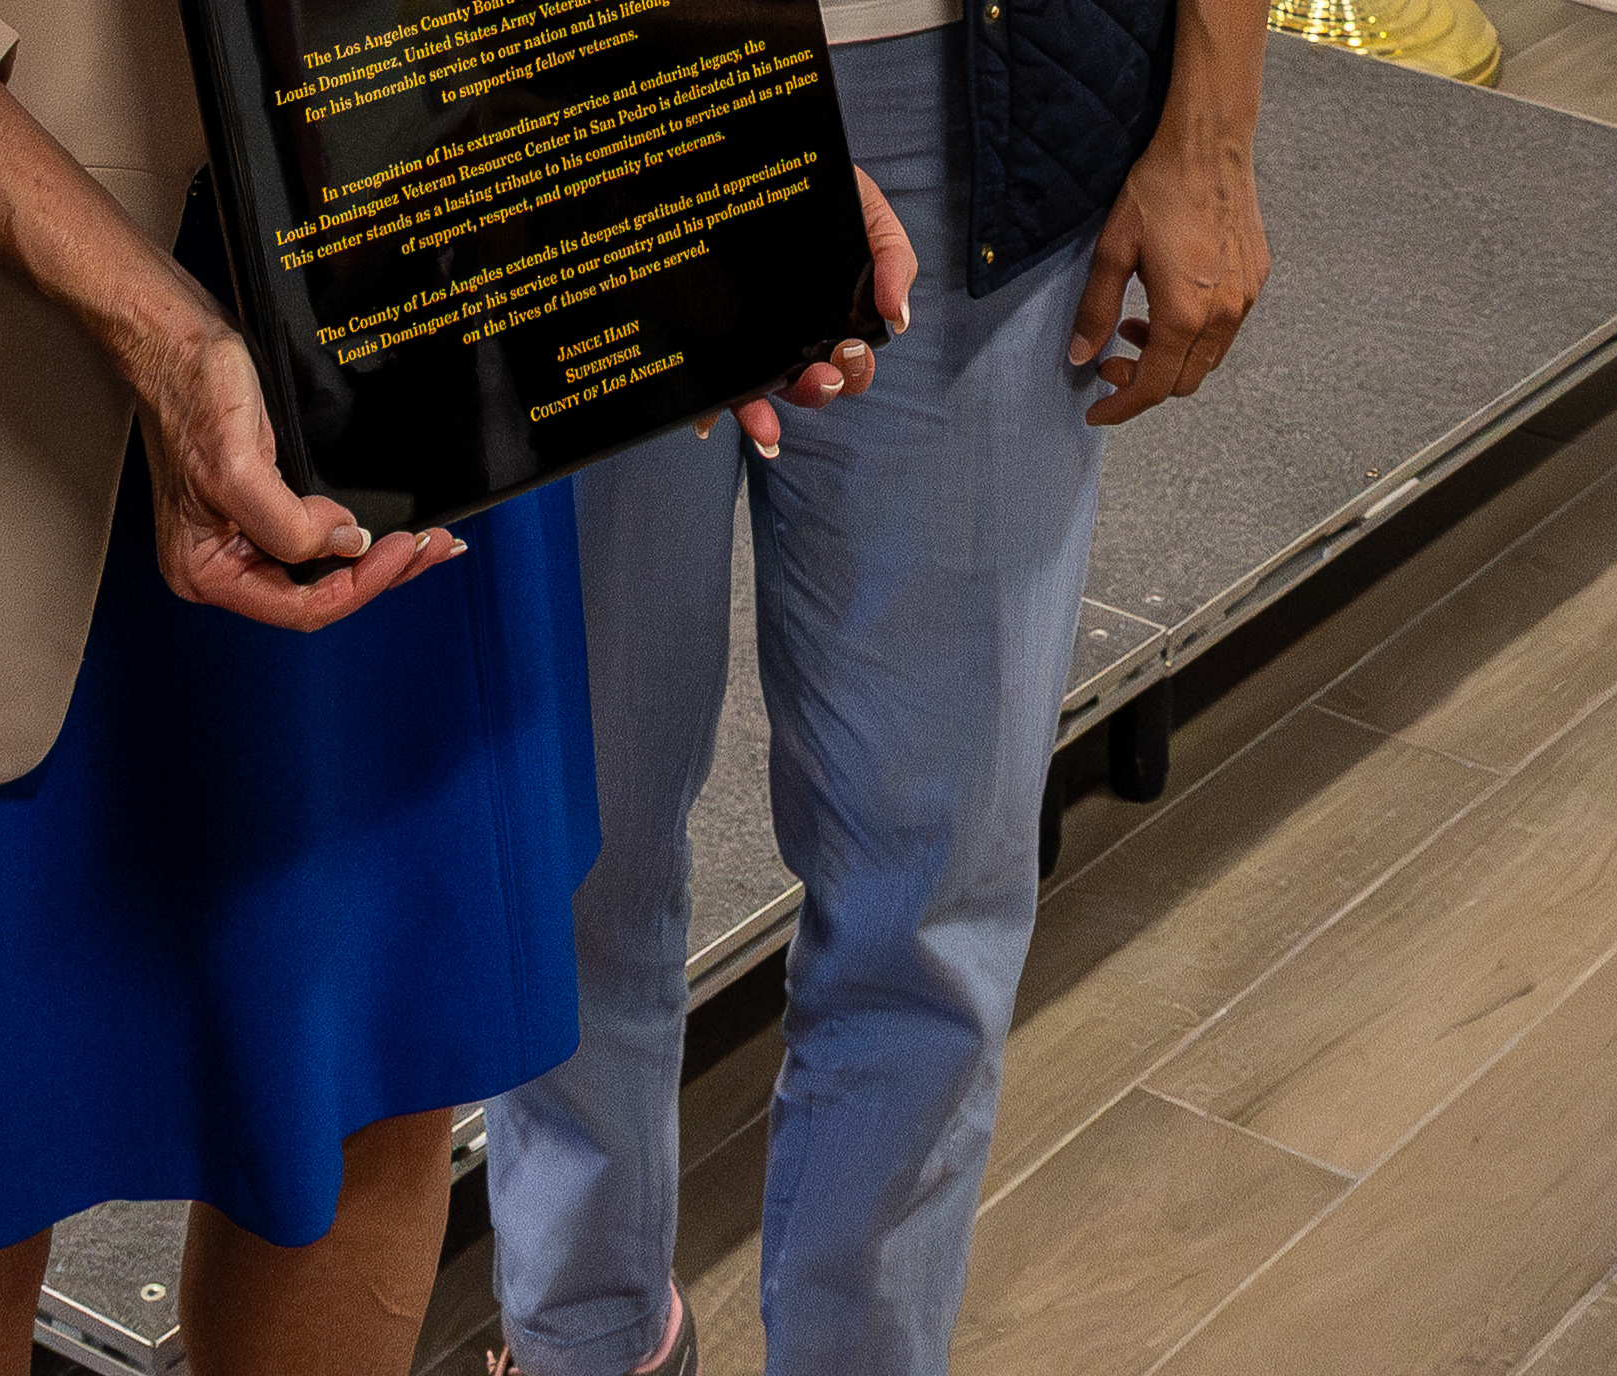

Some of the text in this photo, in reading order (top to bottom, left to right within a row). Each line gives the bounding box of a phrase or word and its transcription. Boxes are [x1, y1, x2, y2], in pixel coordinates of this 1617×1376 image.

[274, 81, 317, 106] Louis
[317, 56, 403, 93] Dominguez,
[403, 34, 453, 64] United
[453, 24, 498, 47] States
[500, 11, 537, 33] Army
[302, 50, 333, 70] The
[333, 41, 362, 61] Los
[364, 23, 419, 51] Angeles
[419, 6, 471, 32] County
[304, 106, 327, 124] for
[328, 96, 353, 116] his
[353, 71, 427, 107] honorable
[428, 56, 478, 82] service
[479, 50, 496, 65] to
[497, 42, 522, 59] our
[523, 27, 568, 51] nation
[570, 13, 596, 35] and
[596, 8, 619, 26] his
[441, 29, 639, 104] to supporting fellow veterans.
[556, 319, 640, 362] JANICE HAHN
[564, 344, 642, 384] SUPERVISOR
[529, 351, 685, 423] COUNTY OF LOS ANGELES
